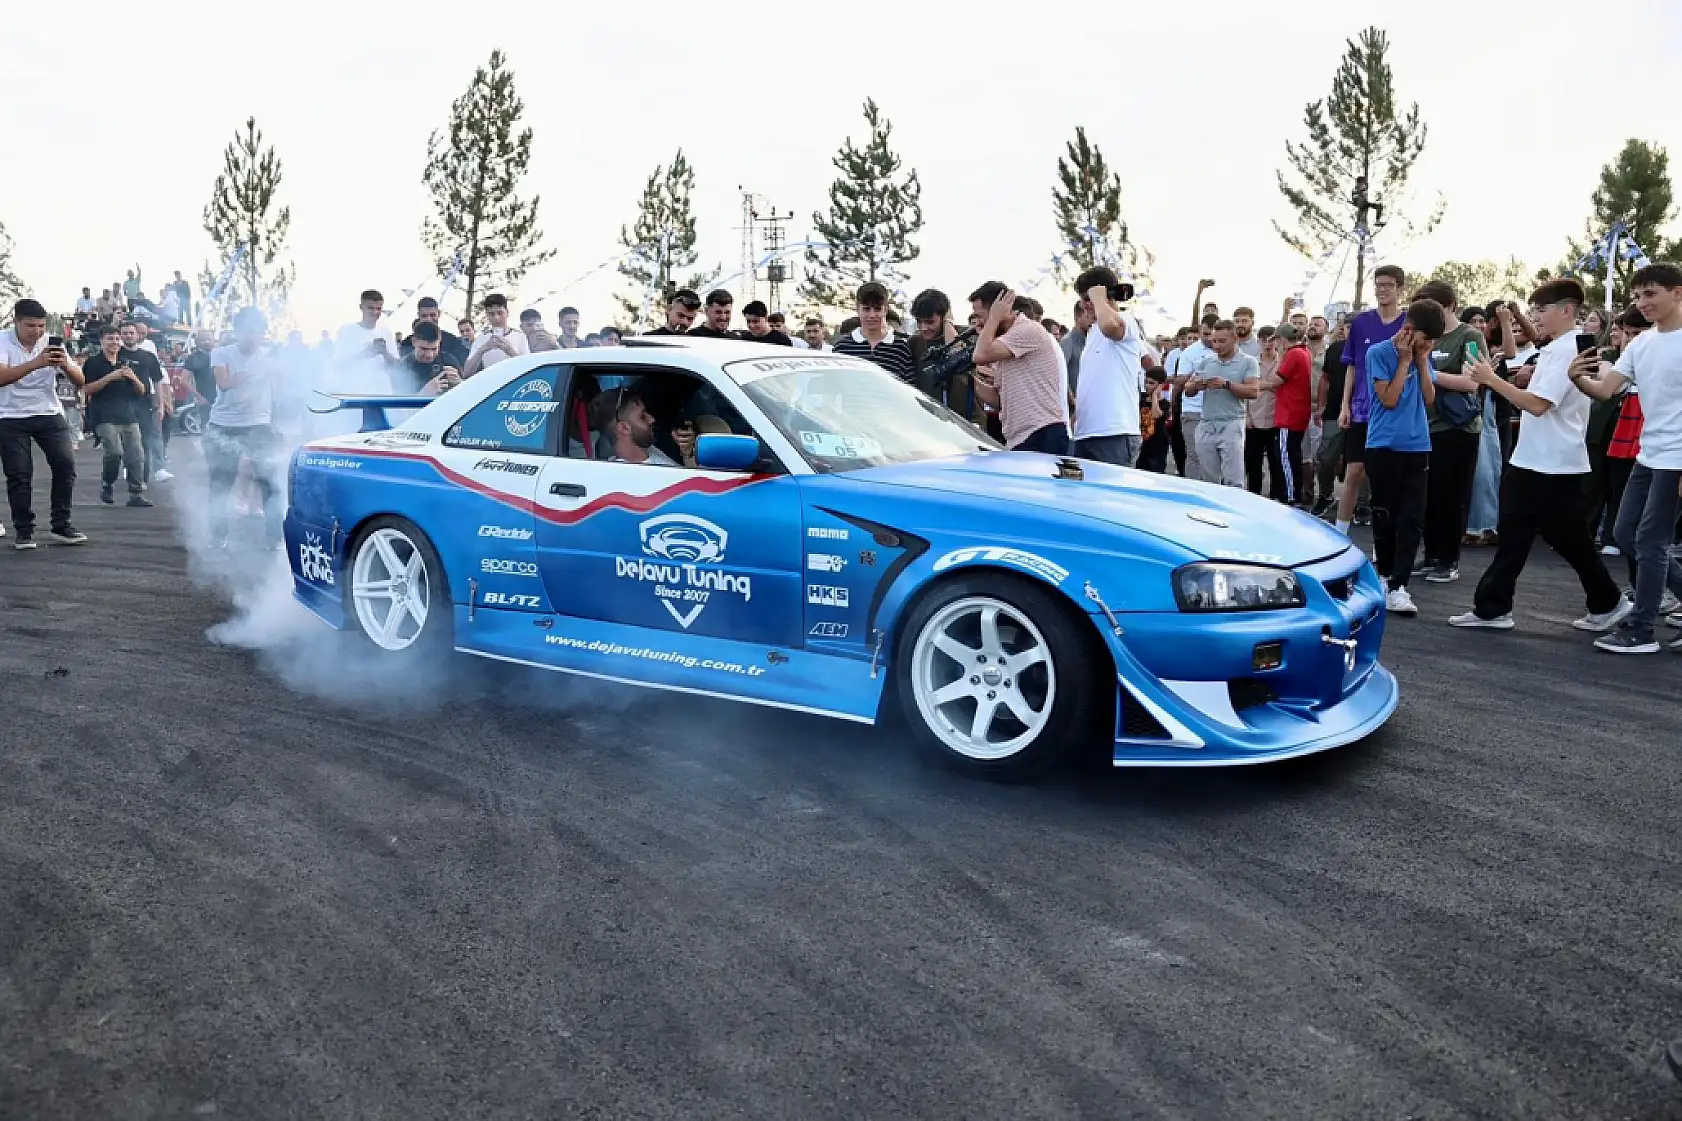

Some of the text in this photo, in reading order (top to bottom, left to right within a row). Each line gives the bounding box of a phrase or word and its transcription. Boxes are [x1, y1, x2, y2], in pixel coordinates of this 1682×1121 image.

[482, 558, 538, 575] sparco
[655, 584, 710, 603] Since 2007
[808, 585, 849, 604] HKS
[809, 622, 848, 638] AEM
[545, 634, 766, 676] www.dejavutuning.com.tr
